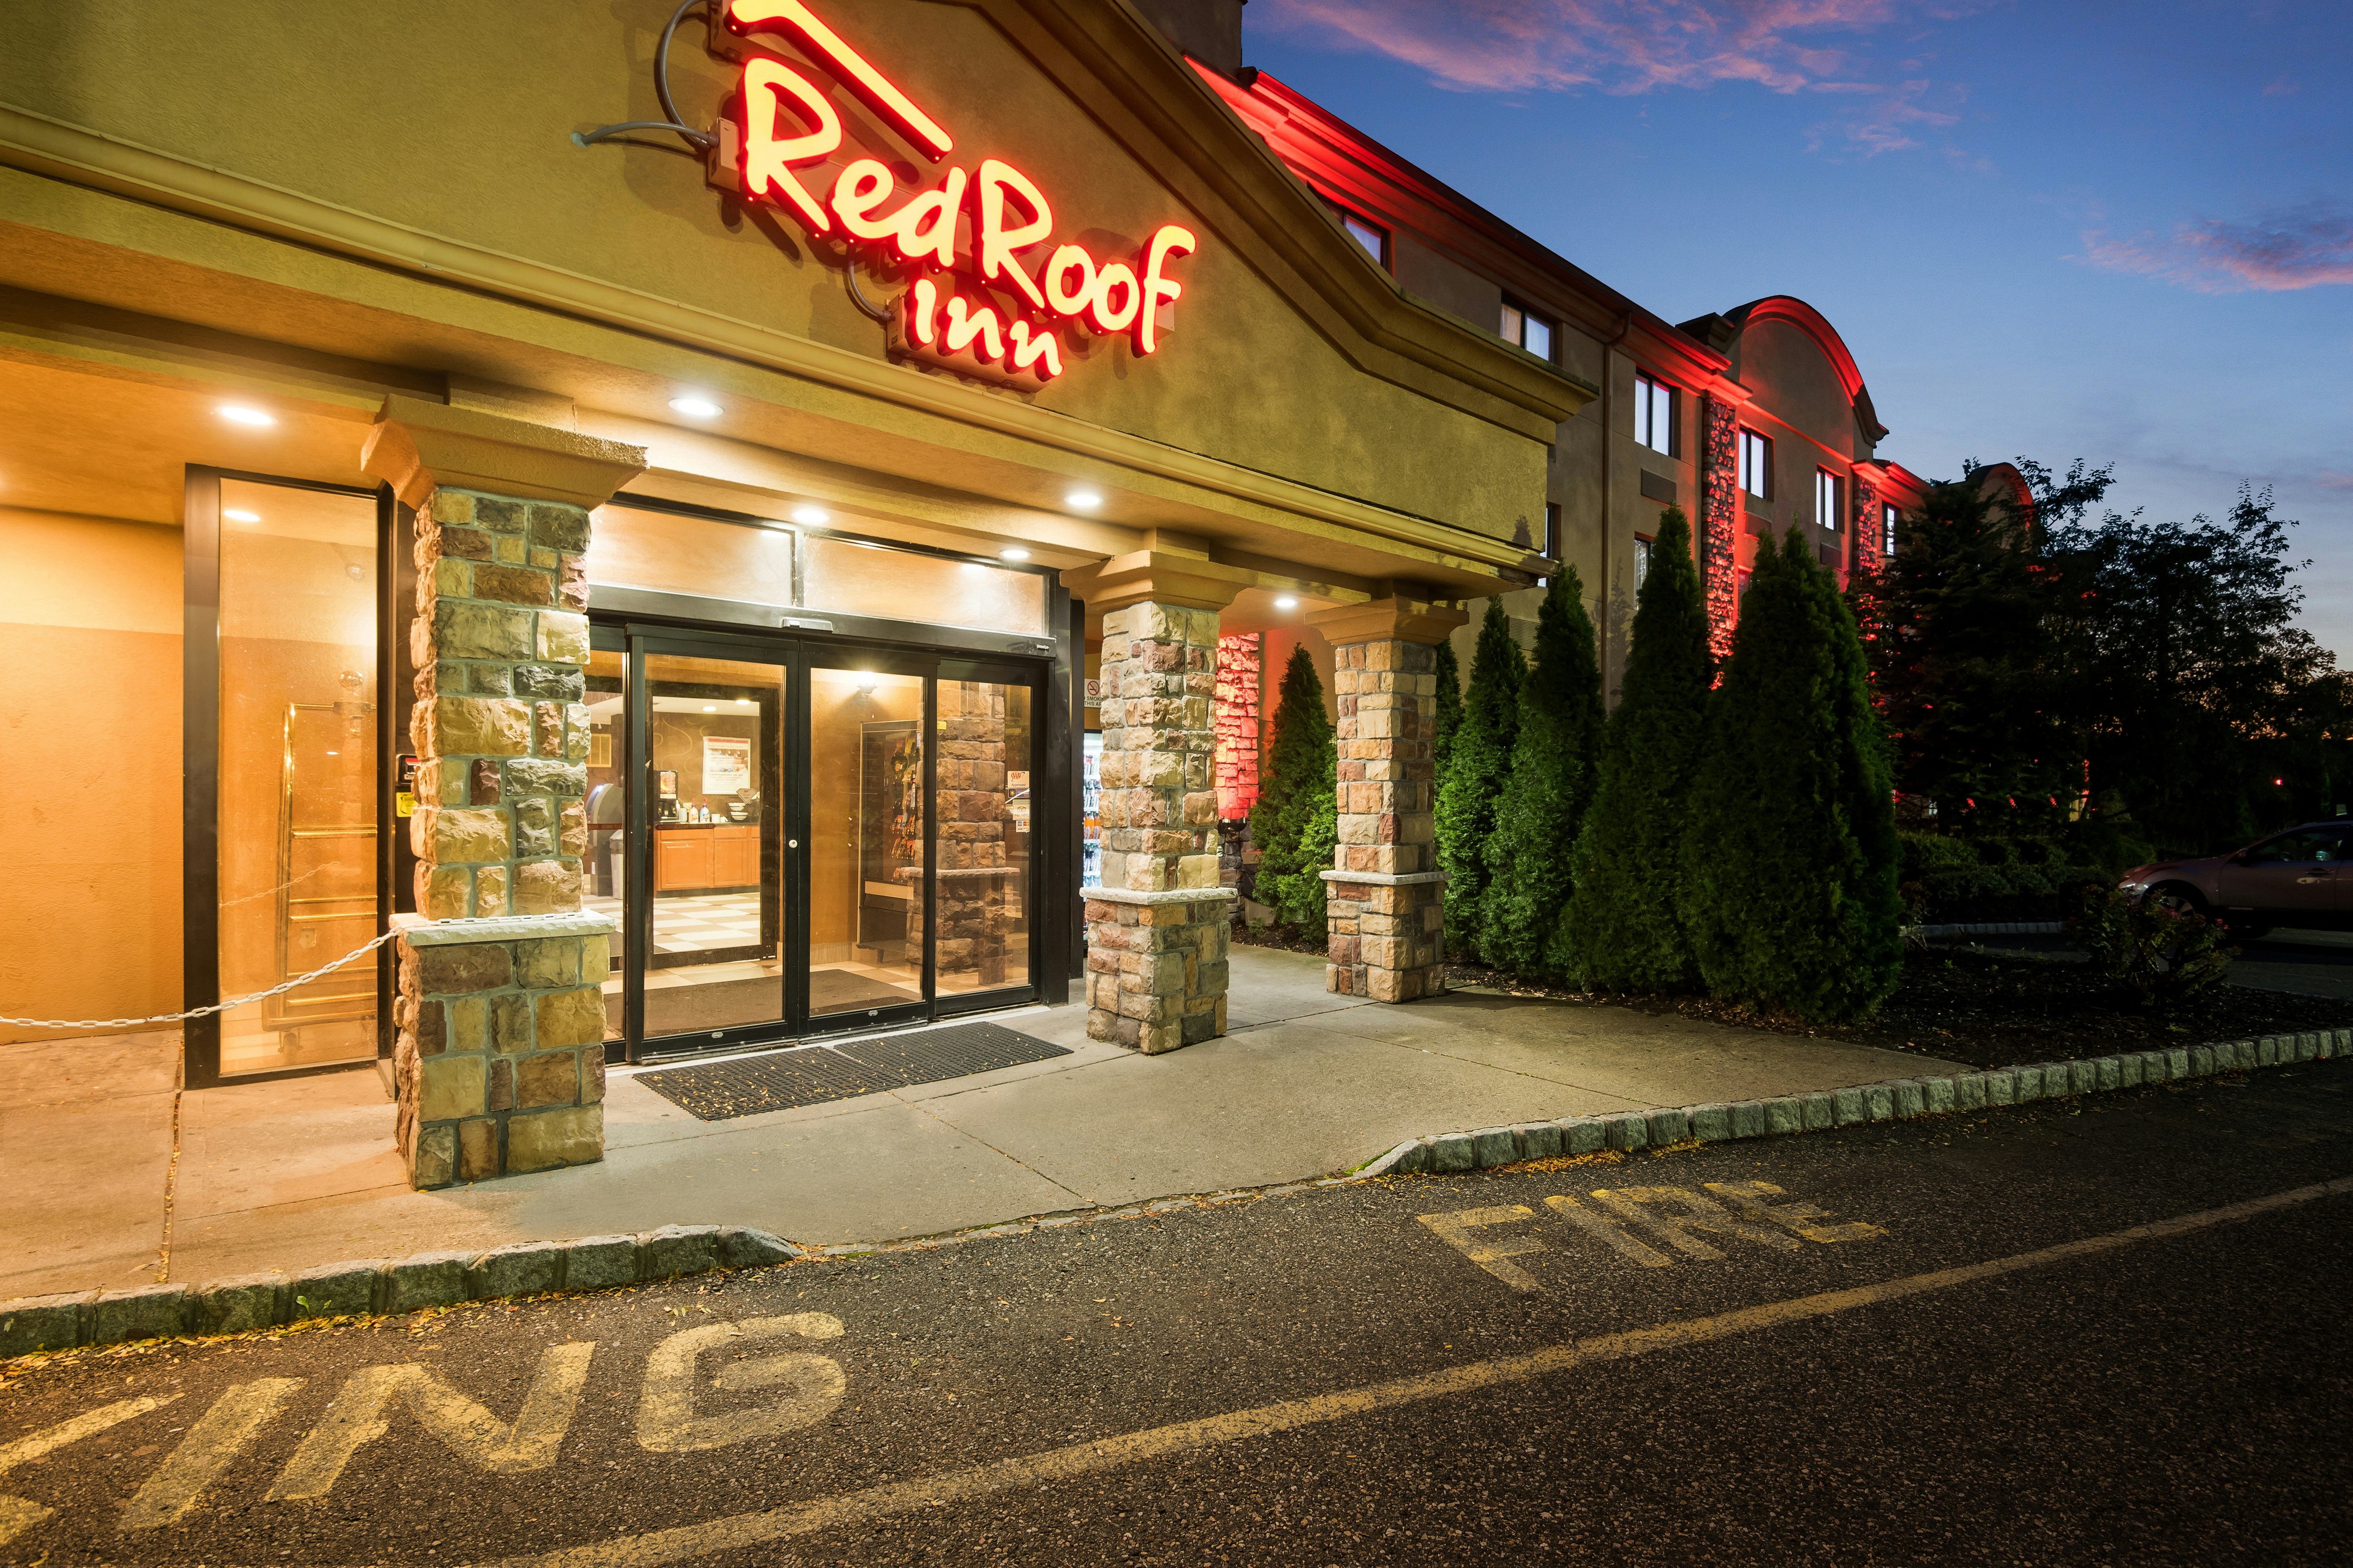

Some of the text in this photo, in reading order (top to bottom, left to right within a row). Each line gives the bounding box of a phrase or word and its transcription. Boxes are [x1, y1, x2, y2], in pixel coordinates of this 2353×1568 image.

[743, 57, 1196, 354] Red Roof
[1416, 1180, 1891, 1291] FIRE
